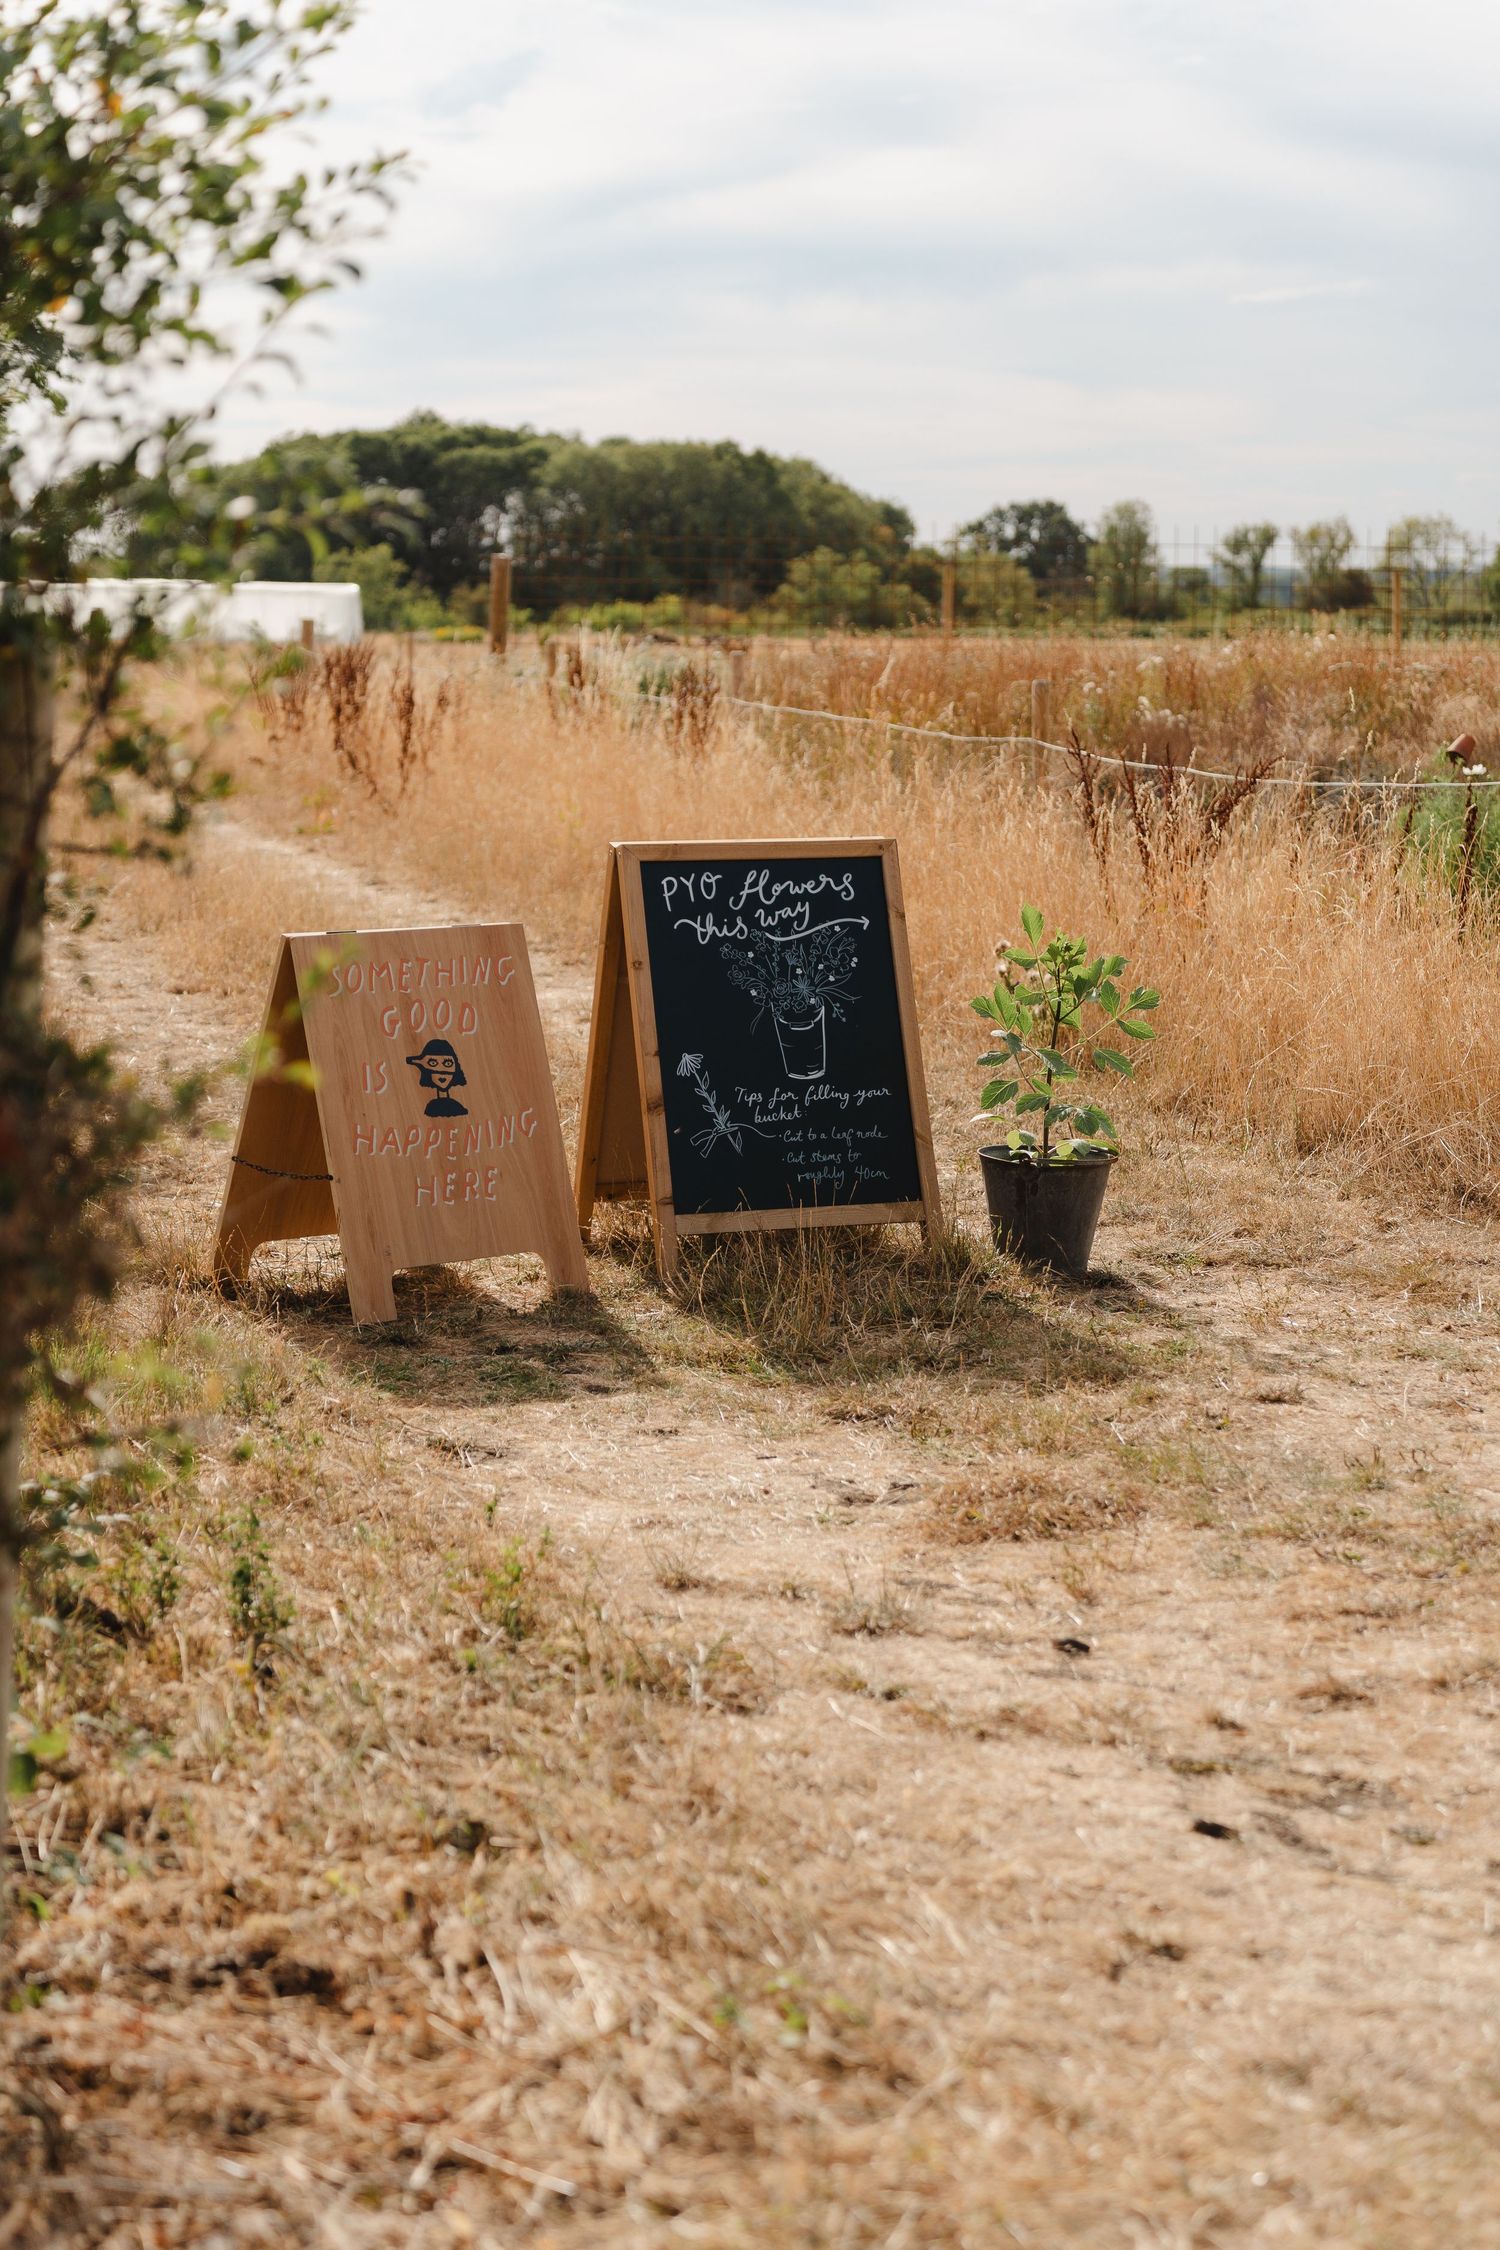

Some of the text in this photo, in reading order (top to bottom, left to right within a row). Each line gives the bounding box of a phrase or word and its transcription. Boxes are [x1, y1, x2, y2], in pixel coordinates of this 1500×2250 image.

[661, 869, 855, 912] PYO flowers
[674, 901, 810, 944] this way
[329, 952, 516, 998] SOMETHING
[380, 998, 479, 1039] GOOD
[361, 1061, 388, 1094] IS
[735, 1084, 892, 1109] Tips for filling your
[352, 1107, 537, 1160] HAPPENING
[807, 1128, 817, 1140] to
[820, 1132, 827, 1140] a
[856, 1124, 889, 1139] node
[797, 1165, 890, 1190] roughly 40cm
[810, 1150, 842, 1164] stems
[415, 1165, 498, 1206] HERE
